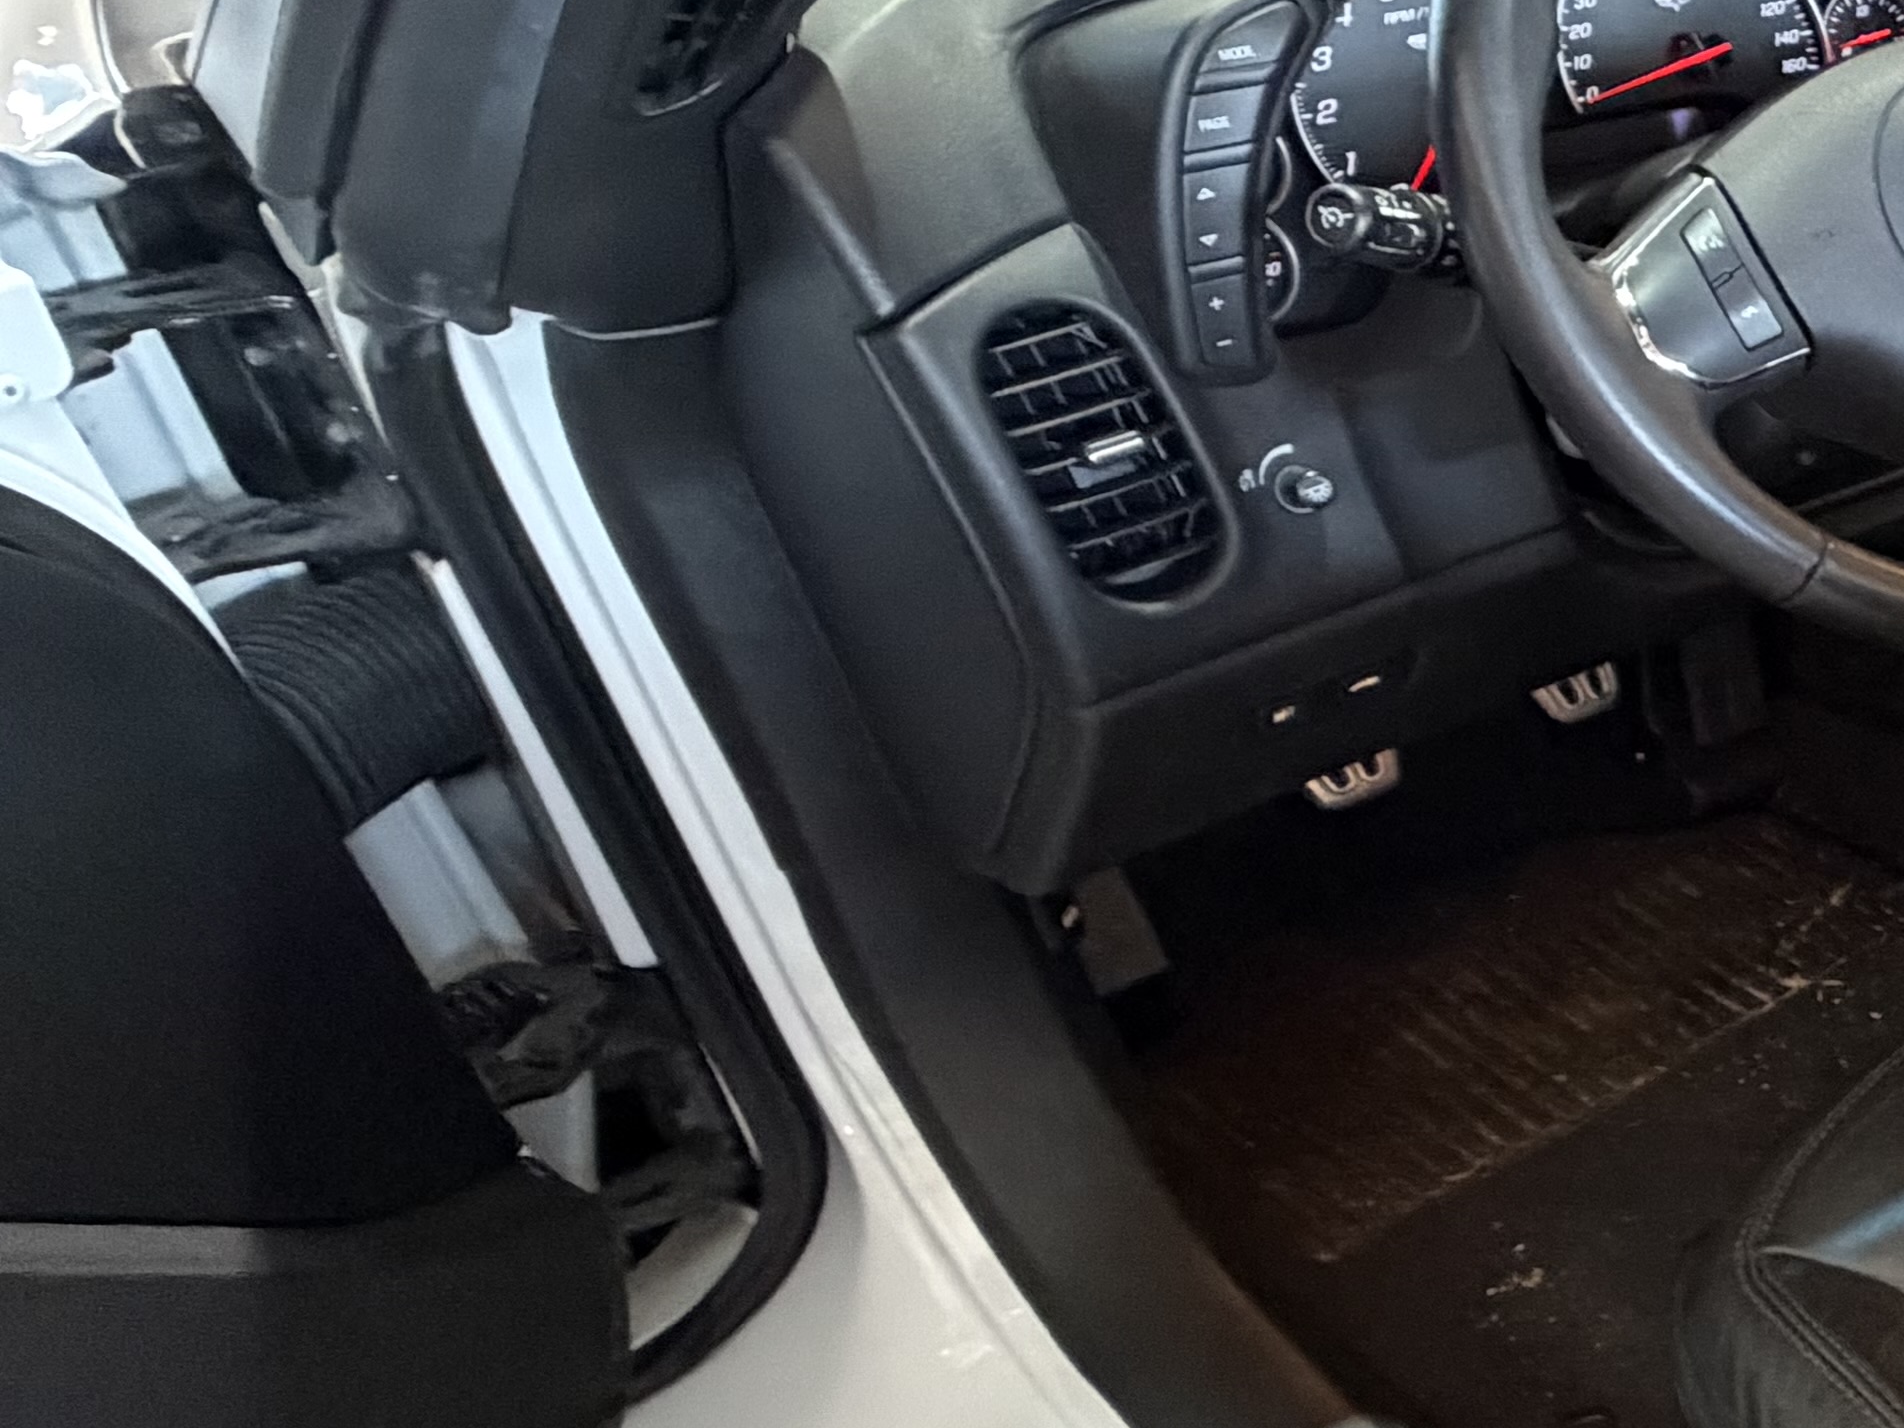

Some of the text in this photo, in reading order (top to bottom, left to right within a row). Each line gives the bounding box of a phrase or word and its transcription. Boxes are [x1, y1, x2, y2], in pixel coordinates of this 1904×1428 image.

[1760, 0, 1786, 18] 120
[1568, 22, 1593, 40] 20
[1774, 29, 1800, 47] 140
[1310, 46, 1333, 72] 3
[1573, 53, 1593, 71] 10
[1781, 57, 1808, 74] 160
[1315, 98, 1339, 125] 2
[1344, 151, 1357, 176] 1
